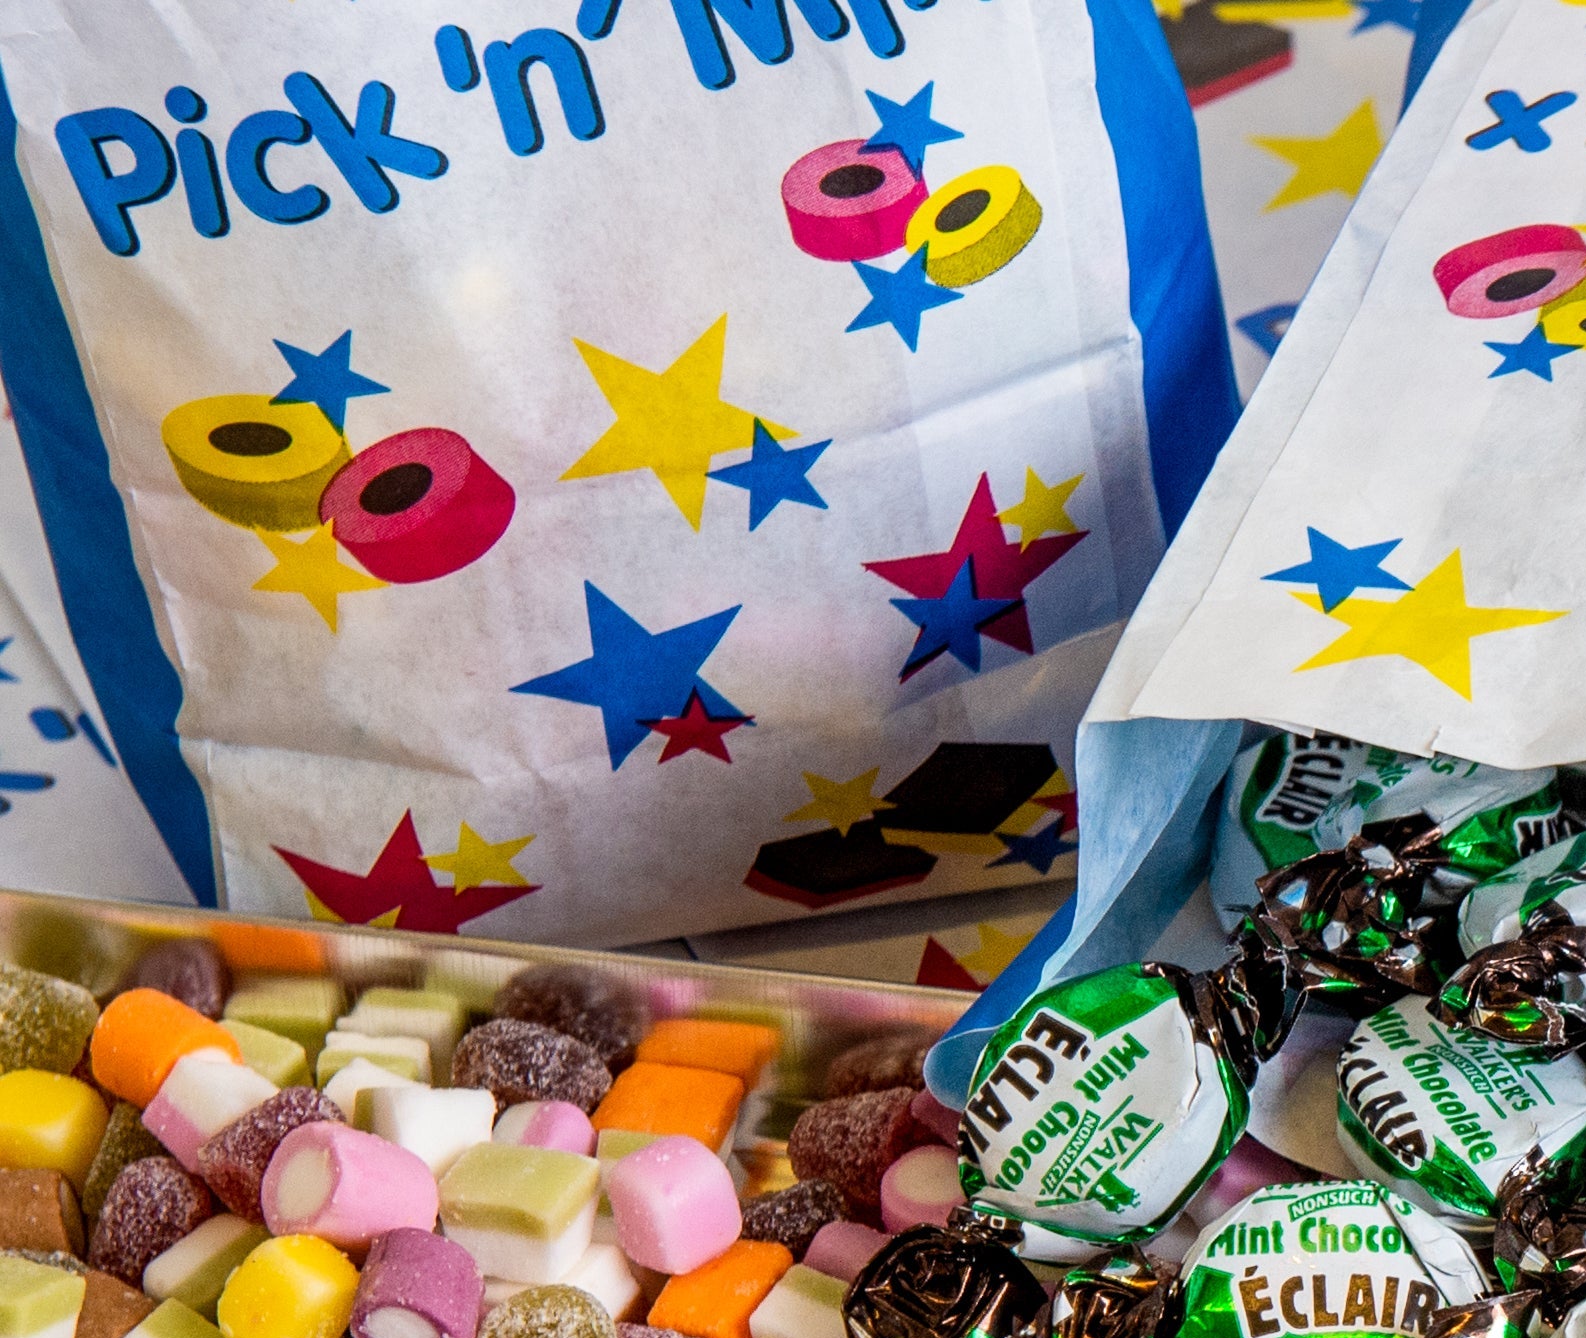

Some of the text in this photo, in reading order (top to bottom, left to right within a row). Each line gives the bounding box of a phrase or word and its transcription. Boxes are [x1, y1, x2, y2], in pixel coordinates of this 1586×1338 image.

[55, 71, 450, 258] Pick
[1073, 1033, 1150, 1104] Mint
[1367, 1006, 1498, 1165] Mint Chocolate
[1430, 1045, 1490, 1093] NONSUCH
[1043, 1112, 1099, 1192] NONSUCH
[1206, 1220, 1285, 1258] Mint
[1289, 1190, 1377, 1221] NONSUCH
[1238, 1265, 1440, 1338] ÉCLAIR
